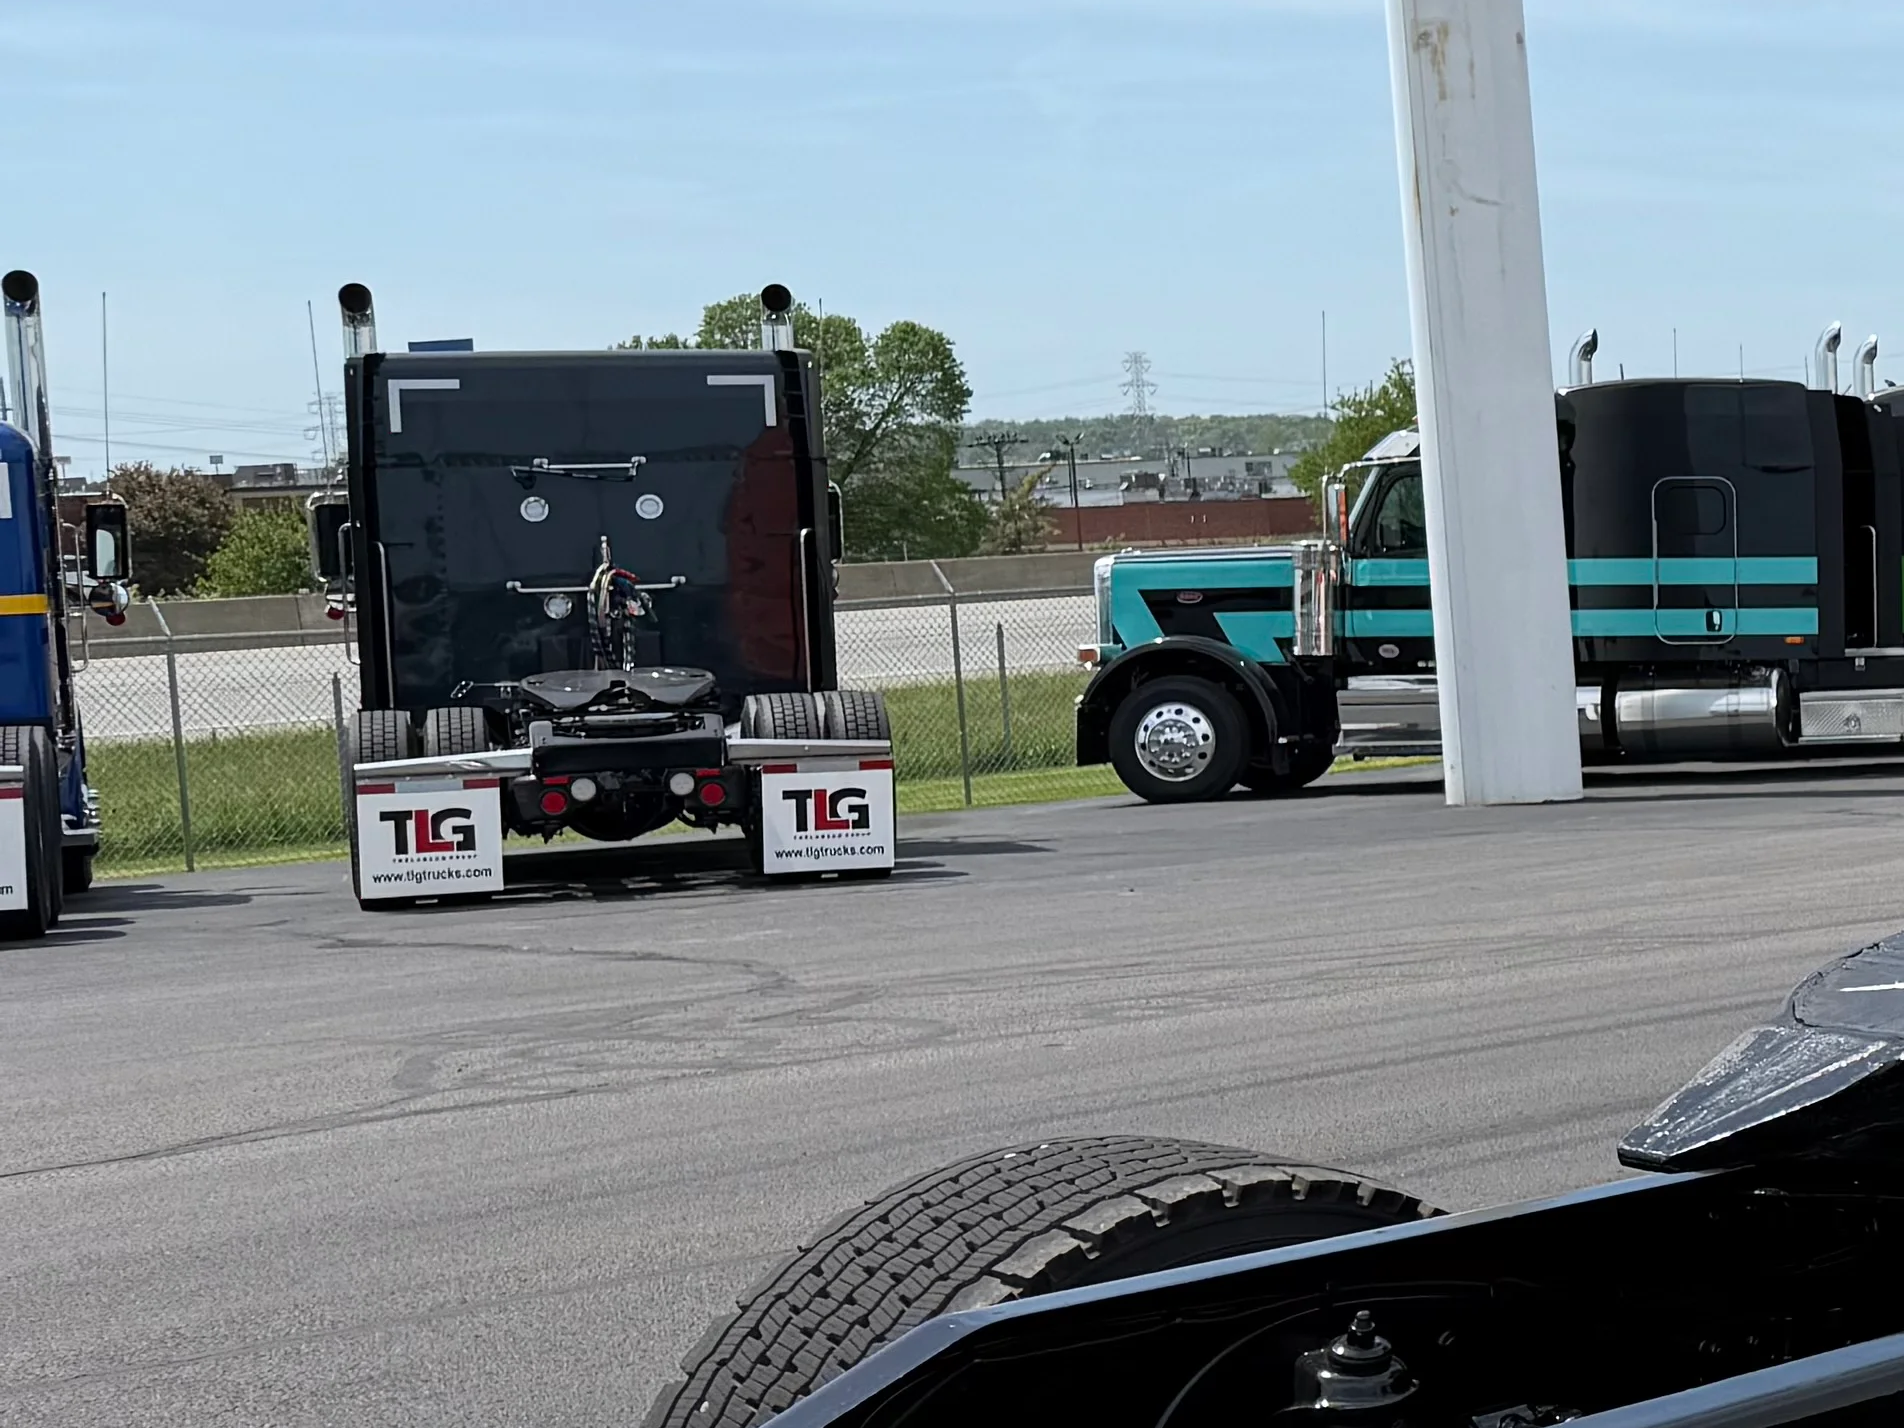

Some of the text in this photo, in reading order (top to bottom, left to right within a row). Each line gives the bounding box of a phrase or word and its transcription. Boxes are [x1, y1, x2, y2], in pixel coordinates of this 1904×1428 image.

[782, 787, 870, 833] TLG
[379, 807, 477, 856] TLG
[774, 845, 885, 860] www.tlgtrucks.com
[372, 867, 492, 884] www.tlgtrucks.com
